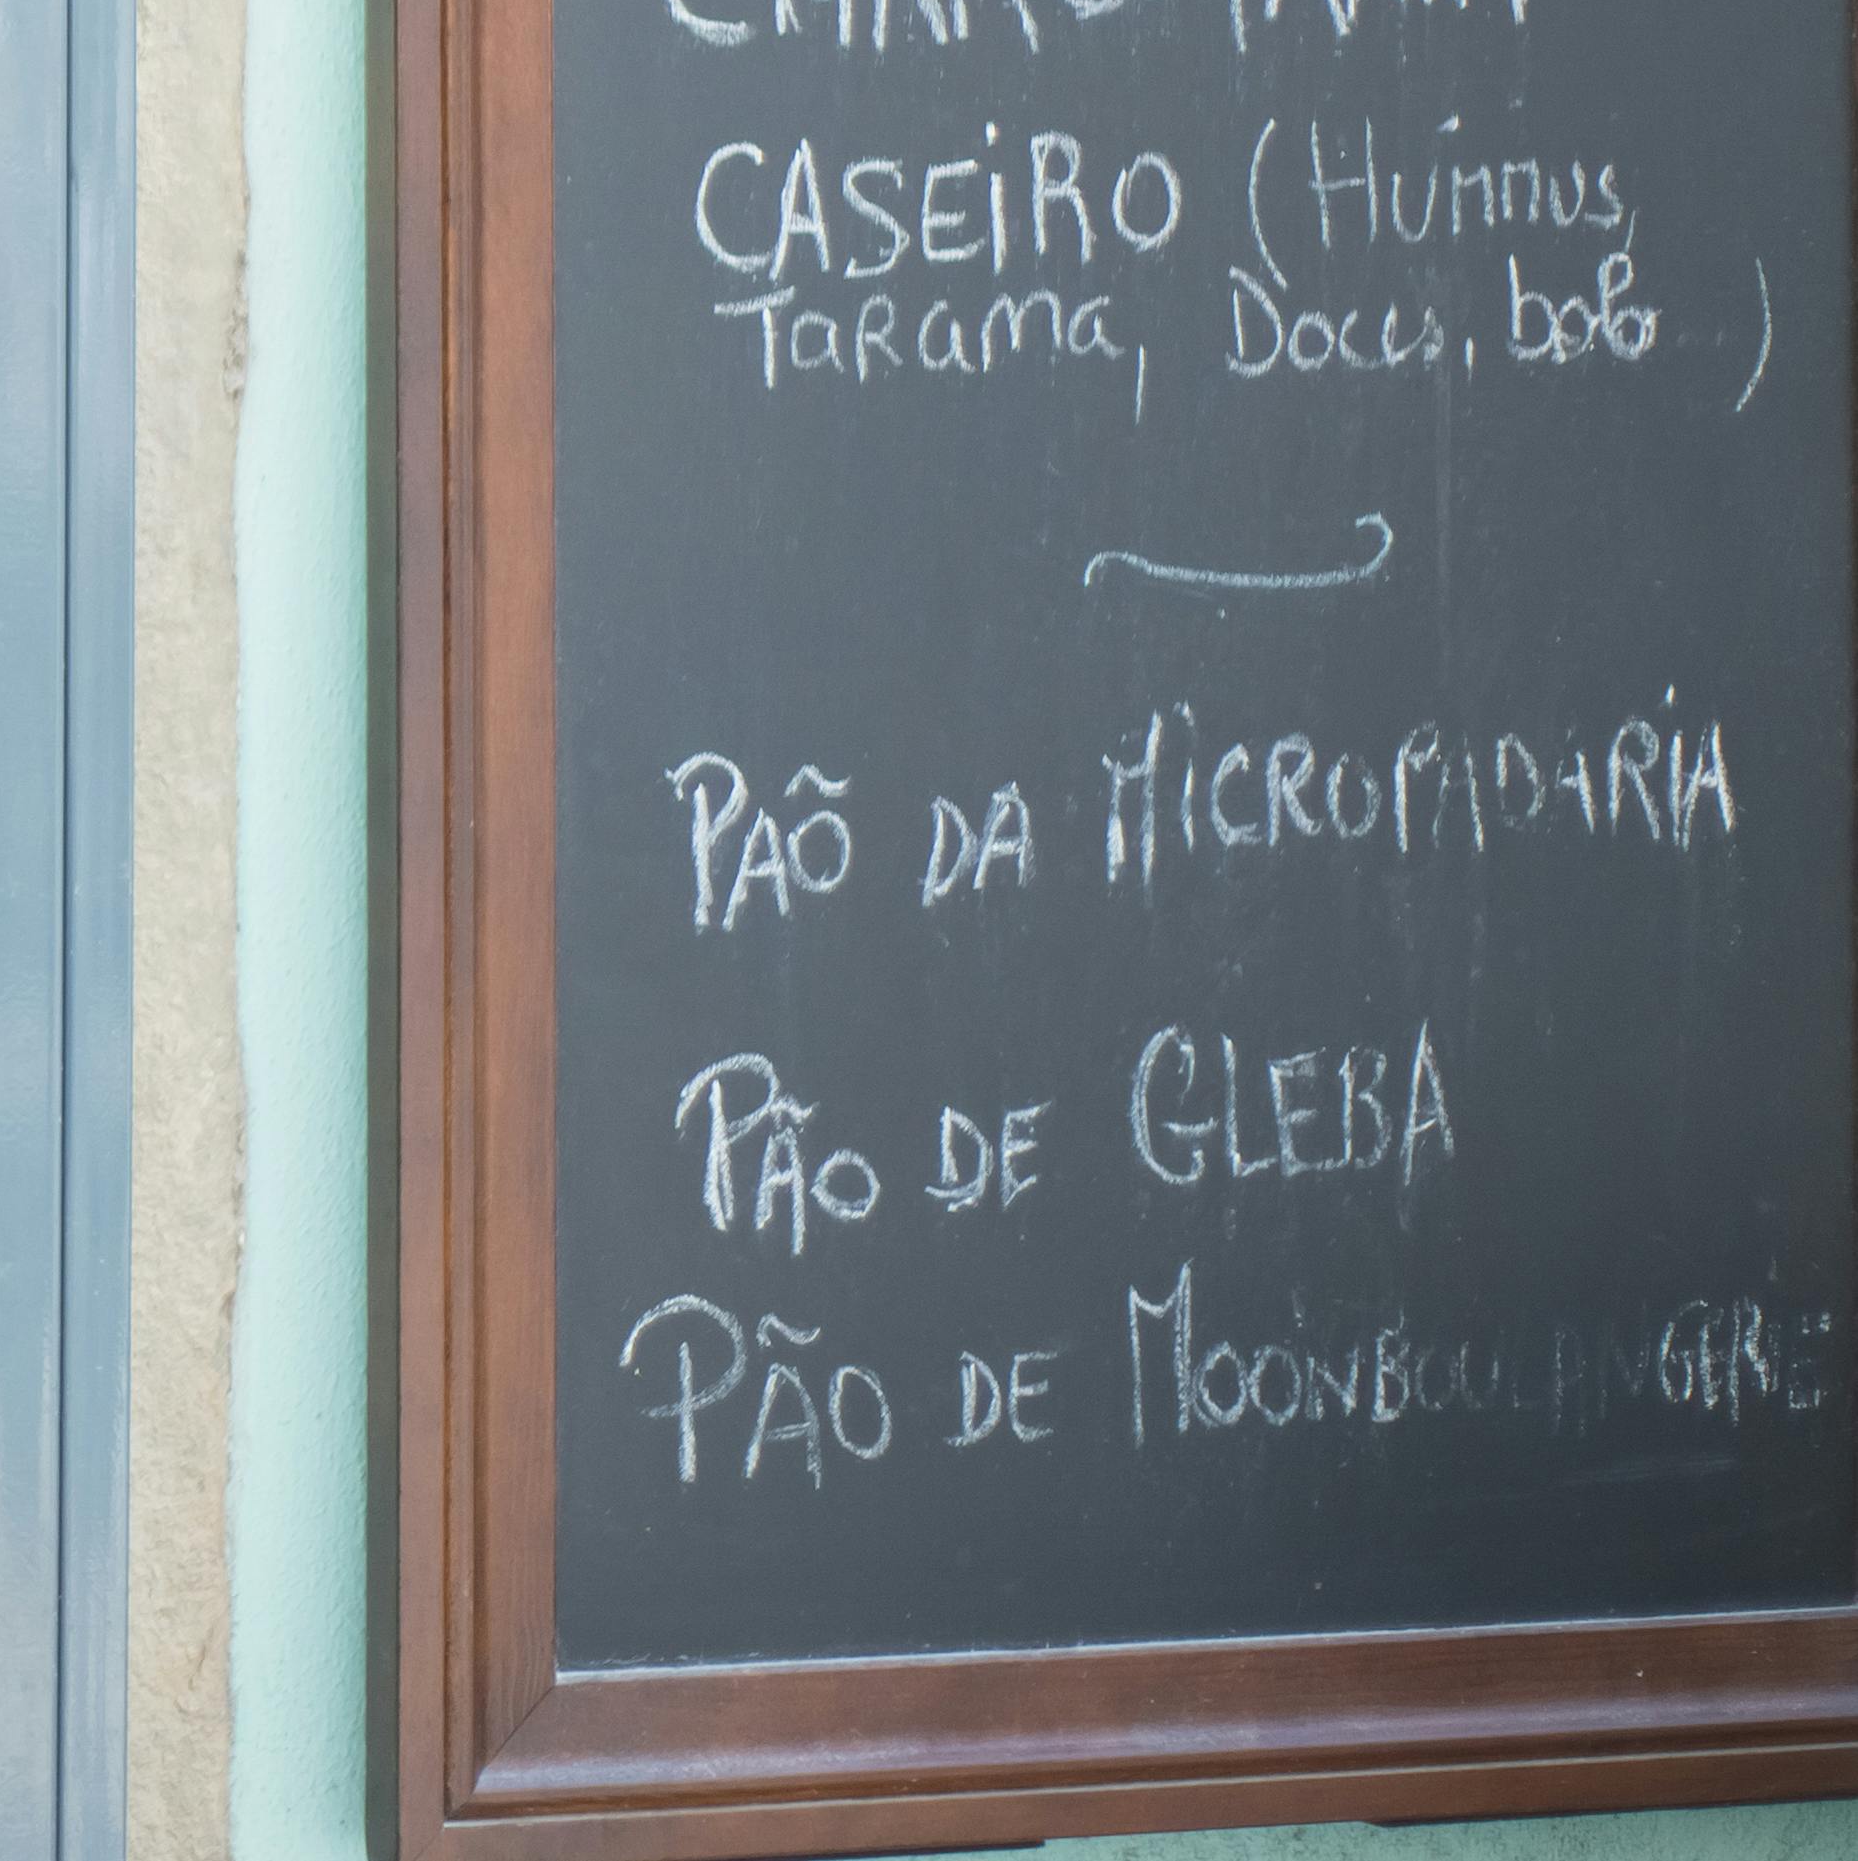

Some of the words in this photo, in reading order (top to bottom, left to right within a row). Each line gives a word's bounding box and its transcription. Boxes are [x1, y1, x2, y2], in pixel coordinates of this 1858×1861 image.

[918, 781, 1036, 908] DA
[925, 1101, 1052, 1214] DE
[1129, 1019, 1457, 1190] GLEBA
[945, 1350, 1058, 1448] DE
